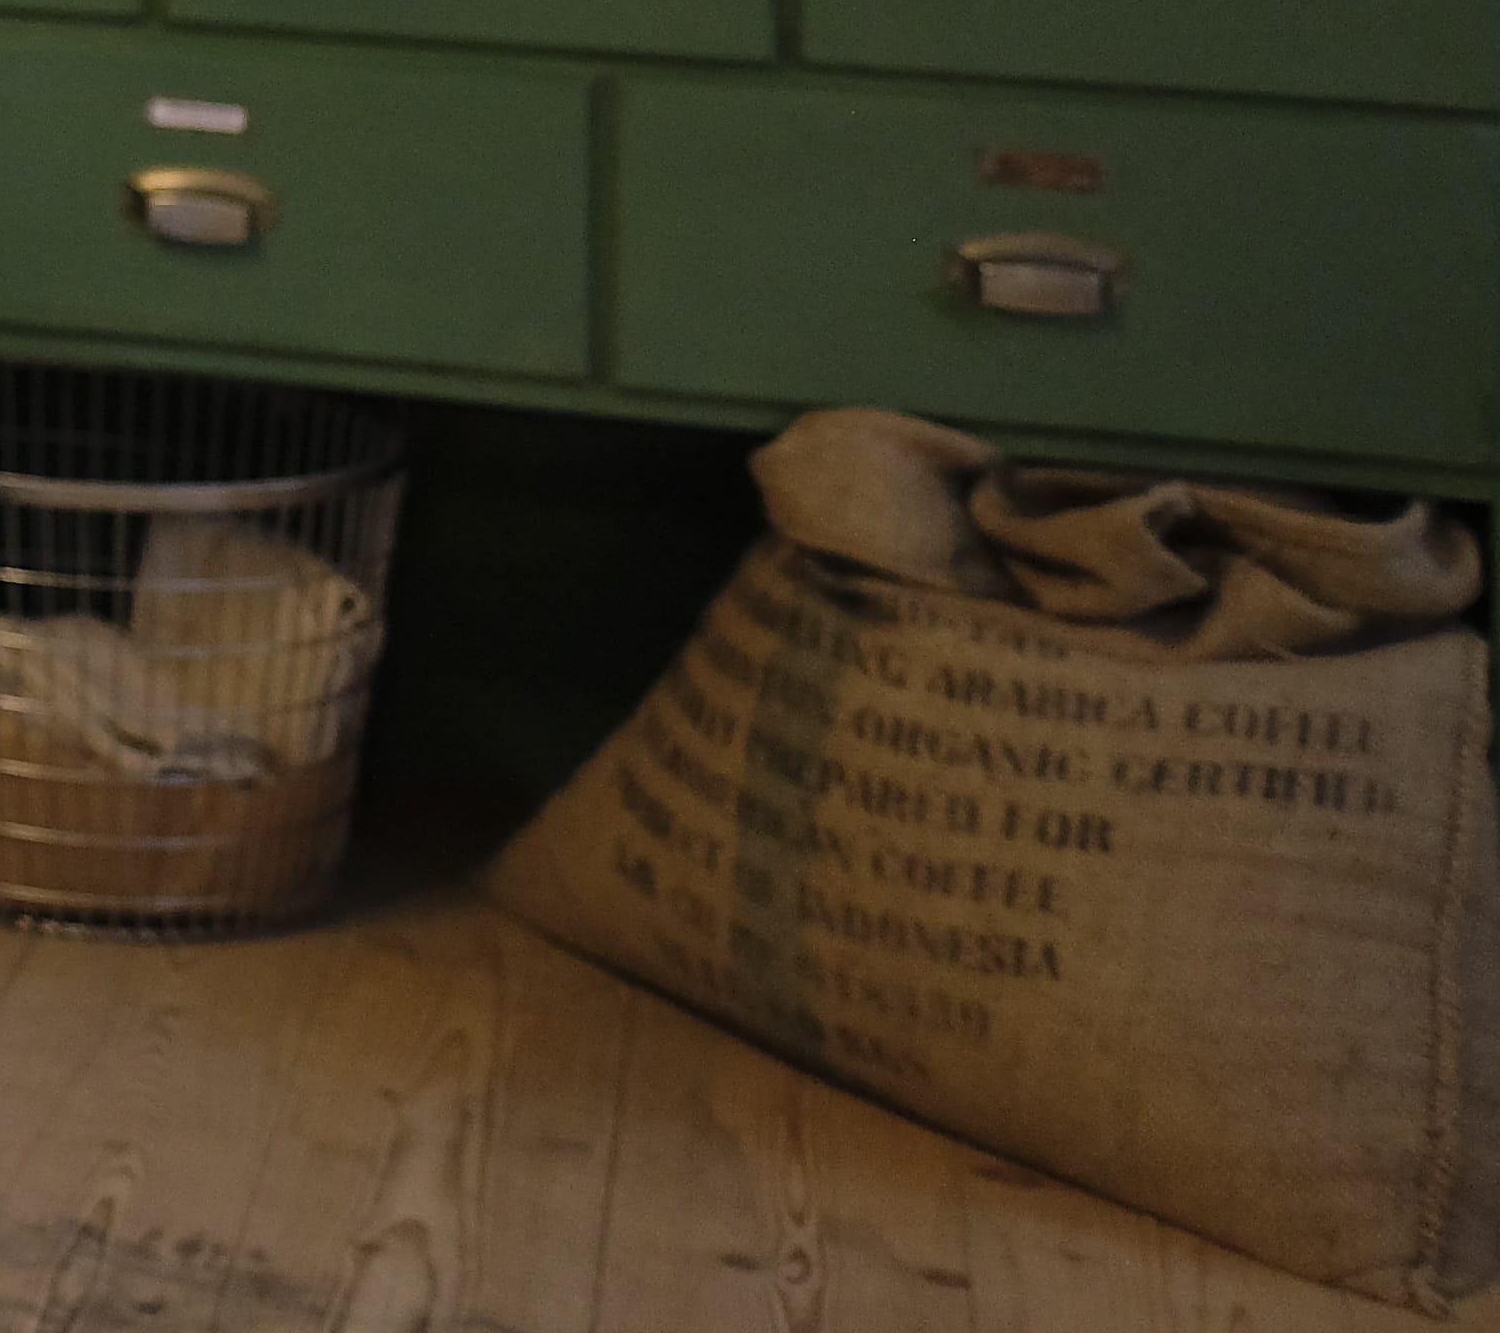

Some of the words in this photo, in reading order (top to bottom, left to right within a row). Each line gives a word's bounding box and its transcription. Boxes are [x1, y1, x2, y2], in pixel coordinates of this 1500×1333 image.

[926, 664, 1160, 730] ARABICA
[1182, 698, 1380, 757] COFFEE
[853, 705, 1092, 785] ORGANIC
[1110, 754, 1400, 815] CERTIFIED
[1002, 801, 1114, 854] FOR
[869, 846, 1060, 915] COFFEE
[795, 880, 1062, 981] INDONESIA
